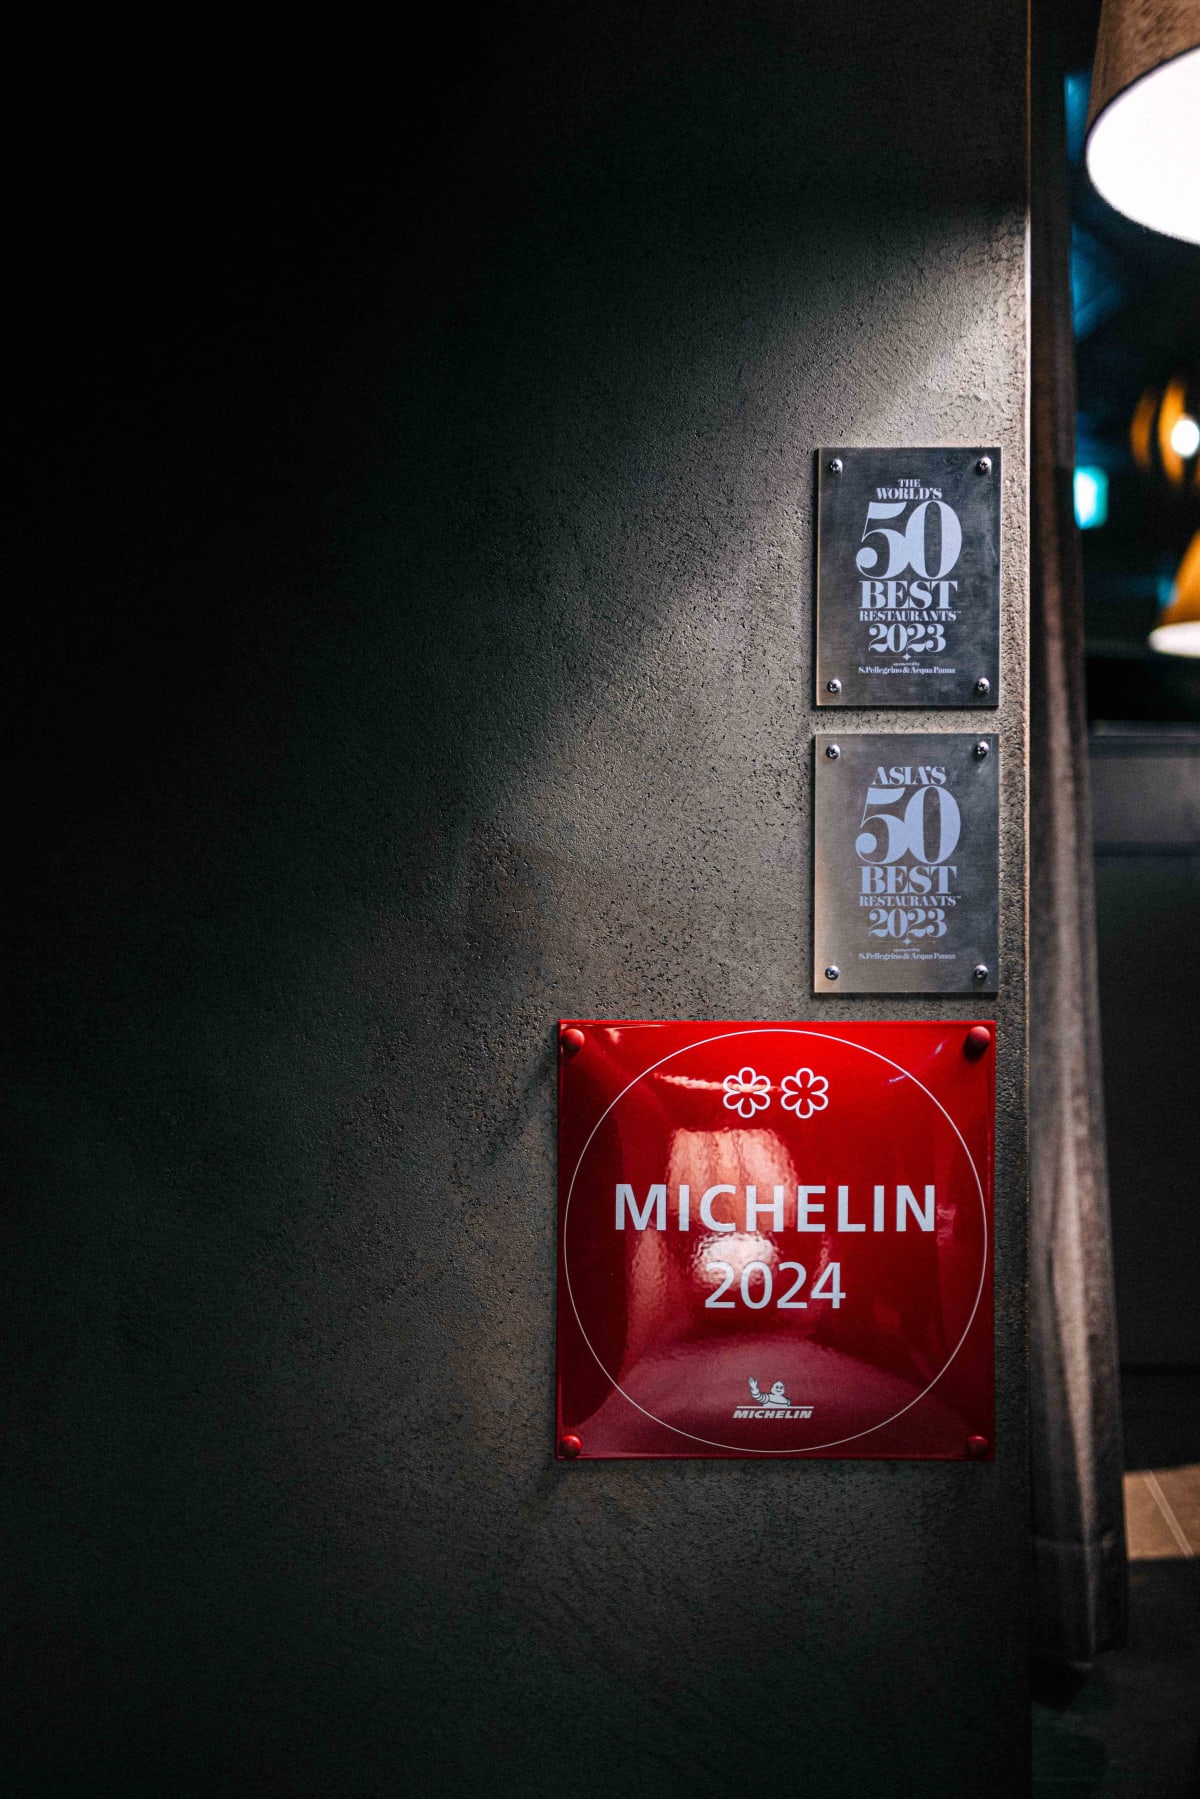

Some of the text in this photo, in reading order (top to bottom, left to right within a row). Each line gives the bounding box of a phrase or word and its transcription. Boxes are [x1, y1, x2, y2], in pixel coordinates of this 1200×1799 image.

[876, 487, 942, 500] WORLD'S
[898, 479, 920, 487] THE
[856, 500, 963, 580] 50
[859, 581, 958, 609] BEST
[868, 623, 947, 653] 2023
[871, 766, 946, 785] ASIA'S
[855, 786, 961, 865] 50
[859, 866, 957, 894] BEST
[868, 908, 948, 938] 2023
[614, 1183, 936, 1233] MICHELIN
[704, 1261, 847, 1309] 2024
[733, 1410, 813, 1419] MICHELIN
